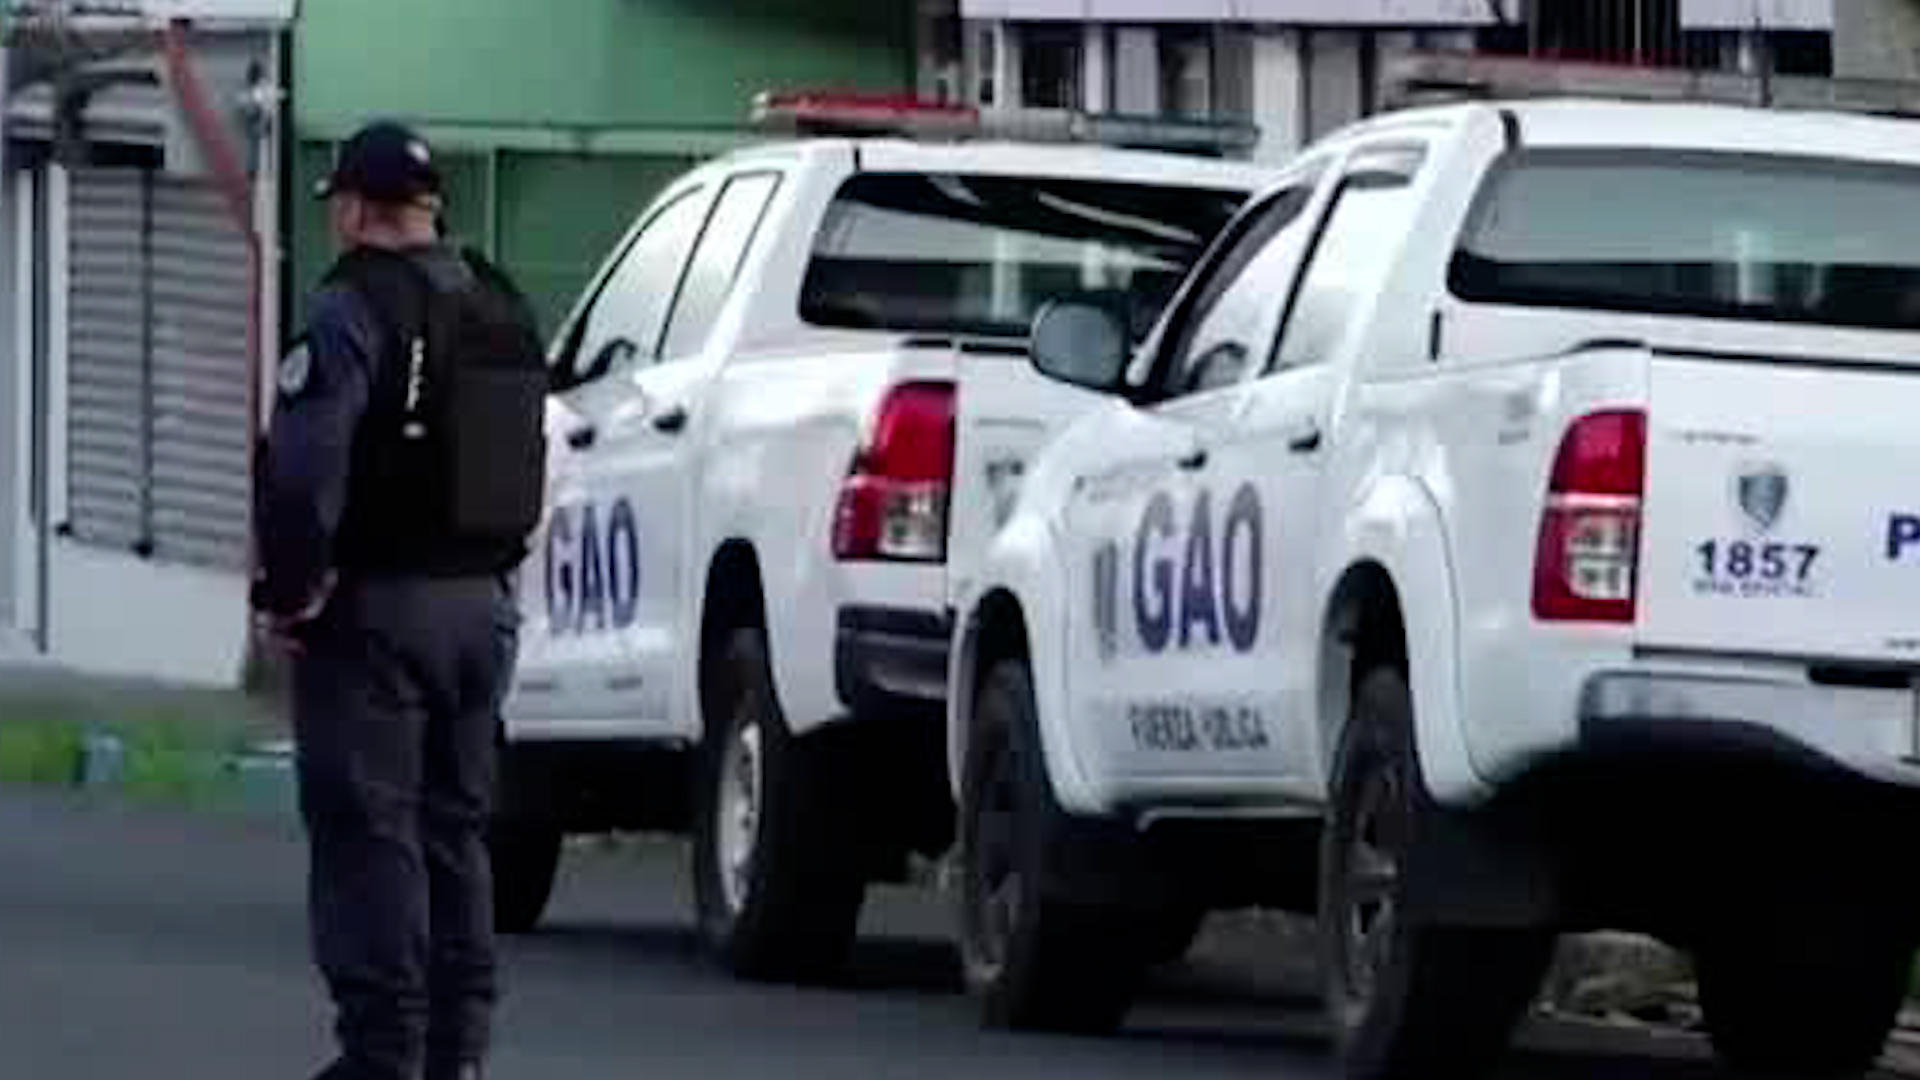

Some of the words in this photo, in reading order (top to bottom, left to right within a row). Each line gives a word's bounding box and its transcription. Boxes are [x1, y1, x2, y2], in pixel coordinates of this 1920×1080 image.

[546, 496, 639, 637] GAO
[1132, 482, 1263, 653] GAO
[1696, 539, 1819, 579] 1857
